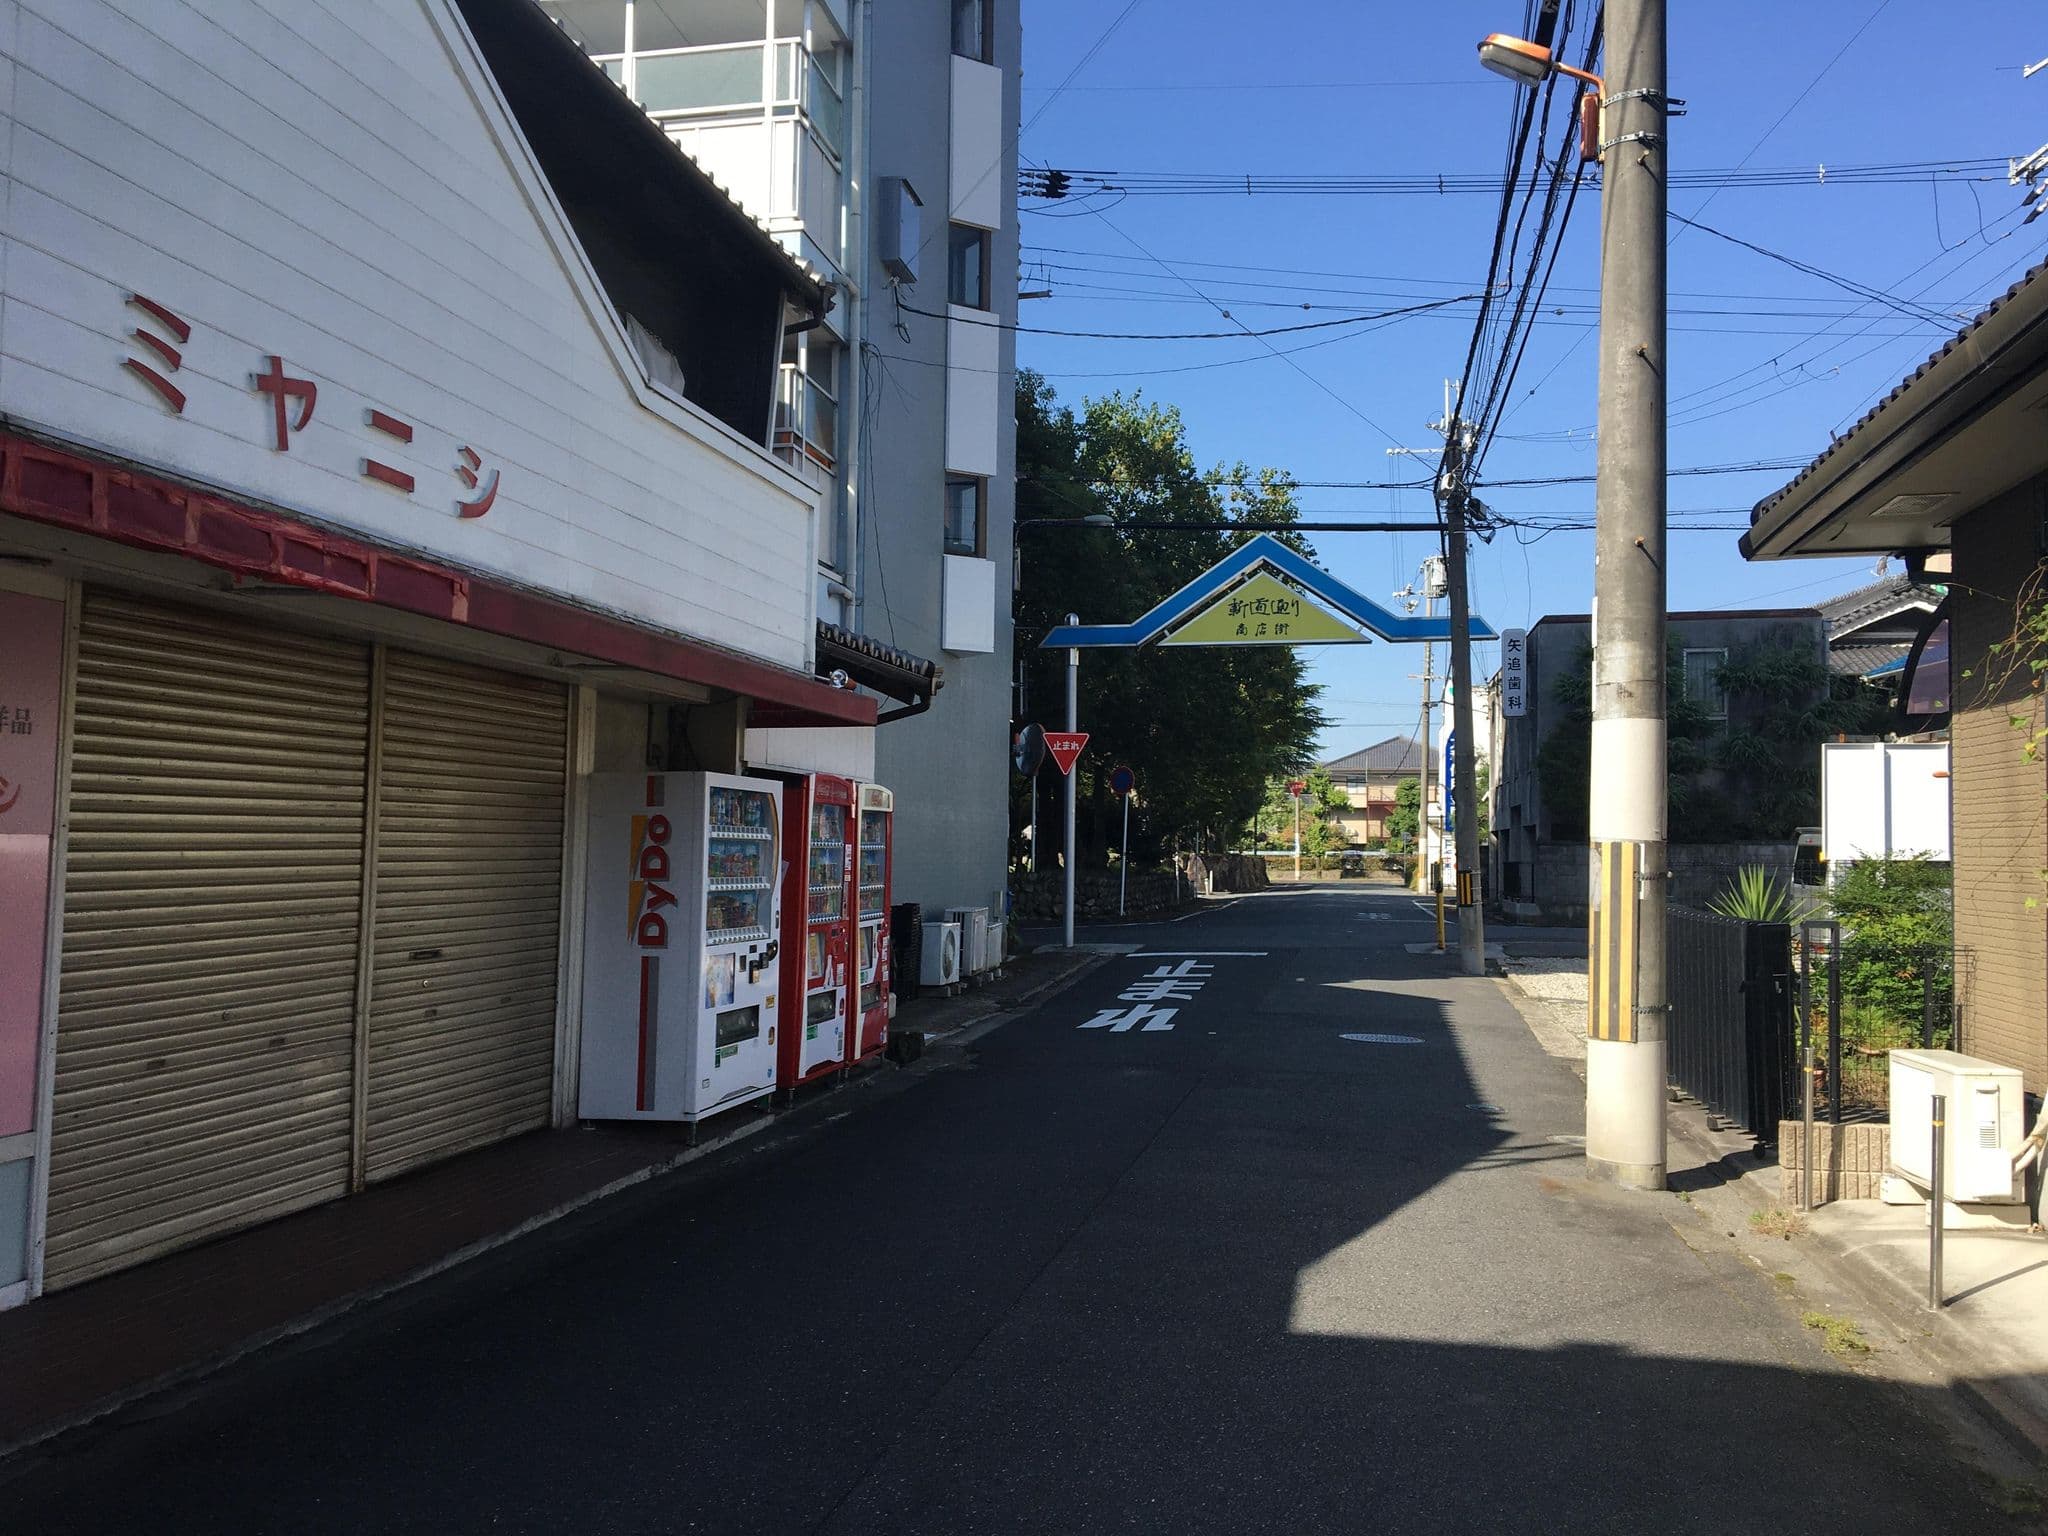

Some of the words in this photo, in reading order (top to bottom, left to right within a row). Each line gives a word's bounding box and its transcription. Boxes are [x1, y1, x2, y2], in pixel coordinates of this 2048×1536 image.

[121, 292, 501, 519] ミヤニシ
[1227, 597, 1300, 618] 新道通り
[1235, 622, 1290, 637] 商店街
[1507, 638, 1522, 710] 矢追歯科
[1052, 740, 1080, 751] 止まれ
[637, 814, 678, 949] DyDo
[1076, 959, 1215, 1033] 止まれ
